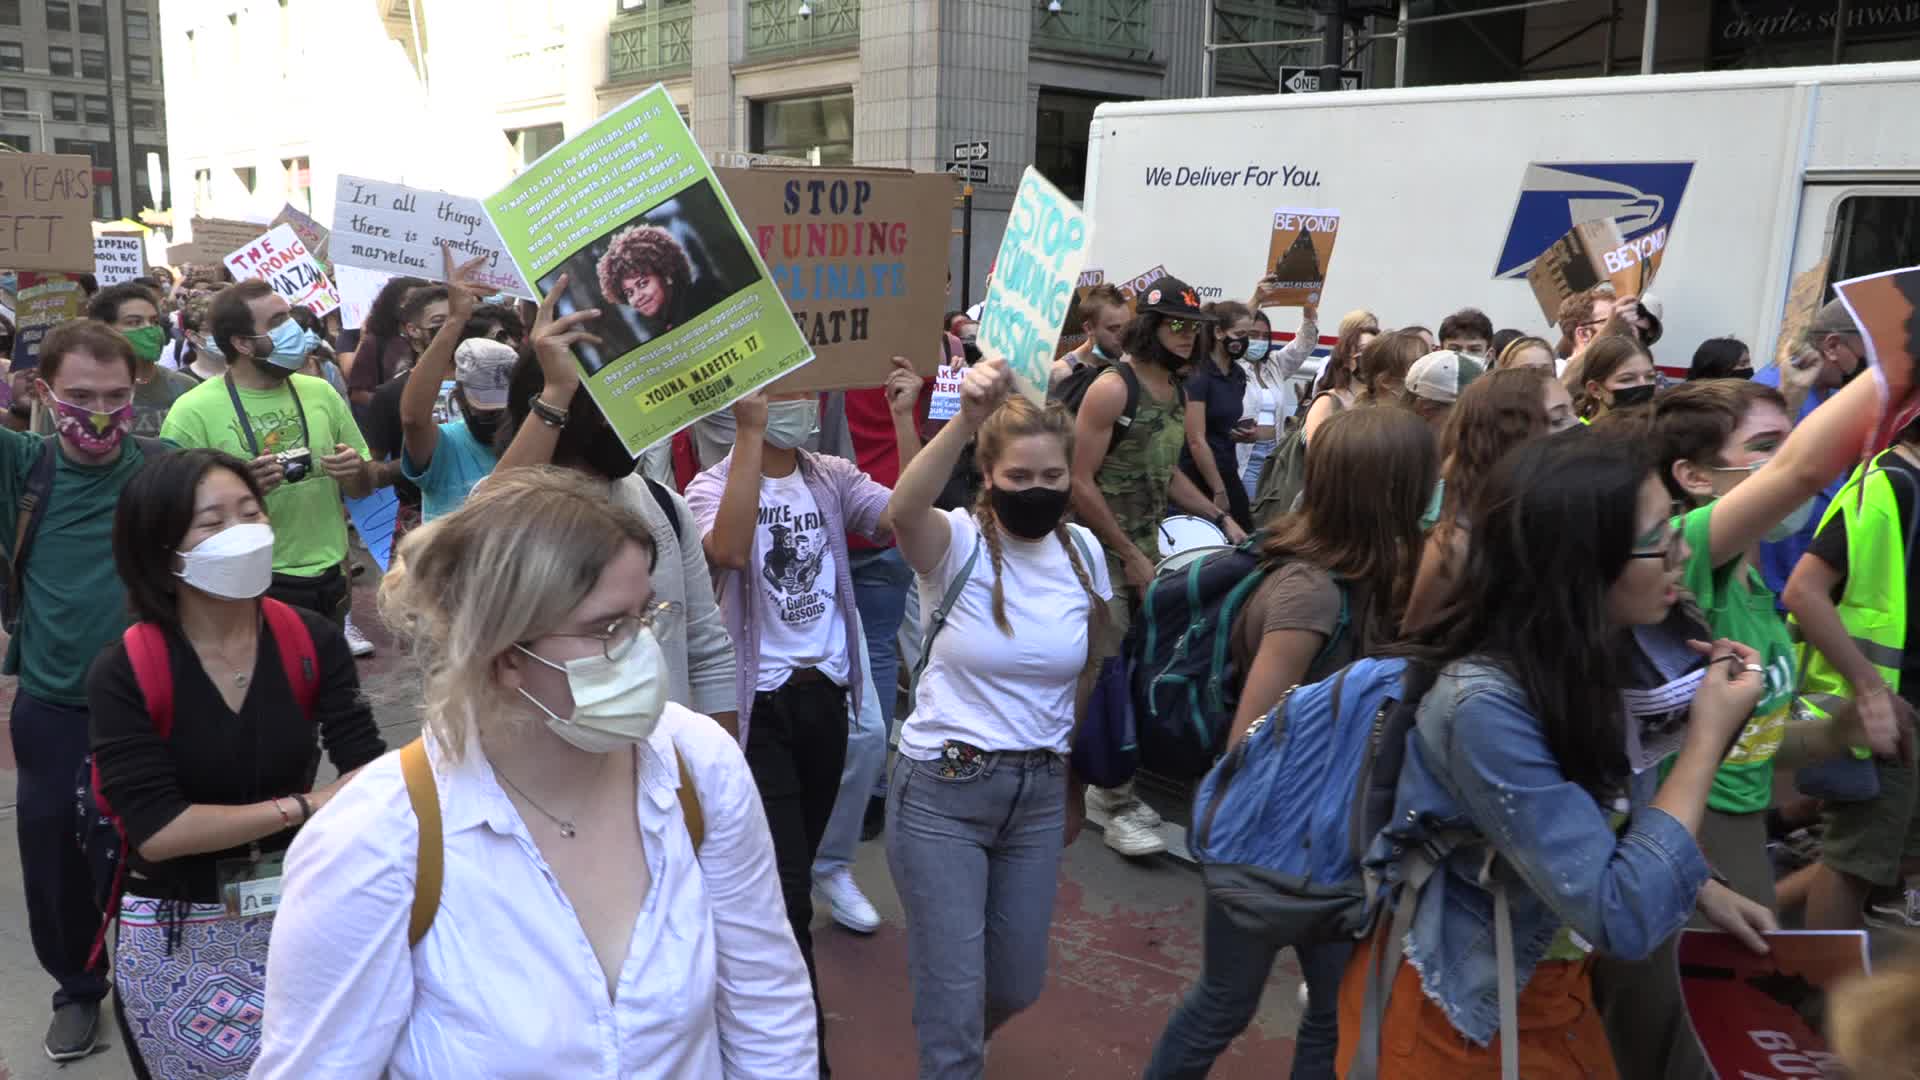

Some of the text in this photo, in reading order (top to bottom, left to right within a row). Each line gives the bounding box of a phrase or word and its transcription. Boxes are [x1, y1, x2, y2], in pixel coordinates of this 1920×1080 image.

[1294, 78, 1317, 90] ONE
[21, 163, 88, 201] YEARS
[539, 175, 553, 188] say
[1145, 165, 1321, 187] We Deliver For You.
[570, 180, 598, 203] growth
[784, 179, 871, 215] STOP
[393, 194, 416, 213] all
[438, 200, 481, 235] things
[1015, 177, 1085, 271] STOP
[1274, 214, 1338, 233] BEYOND
[231, 237, 274, 270] THE
[351, 214, 500, 268] there is something
[754, 222, 908, 258] FUNDING
[1603, 228, 1666, 274] BEYOND
[103, 265, 137, 274] FUTURE
[773, 263, 907, 300] CLIMATE
[744, 335, 760, 352] 17
[688, 373, 734, 406] BELGIUM
[758, 505, 791, 525] MIKE
[781, 602, 825, 621] Lessons
[786, 592, 819, 610] Guitar
